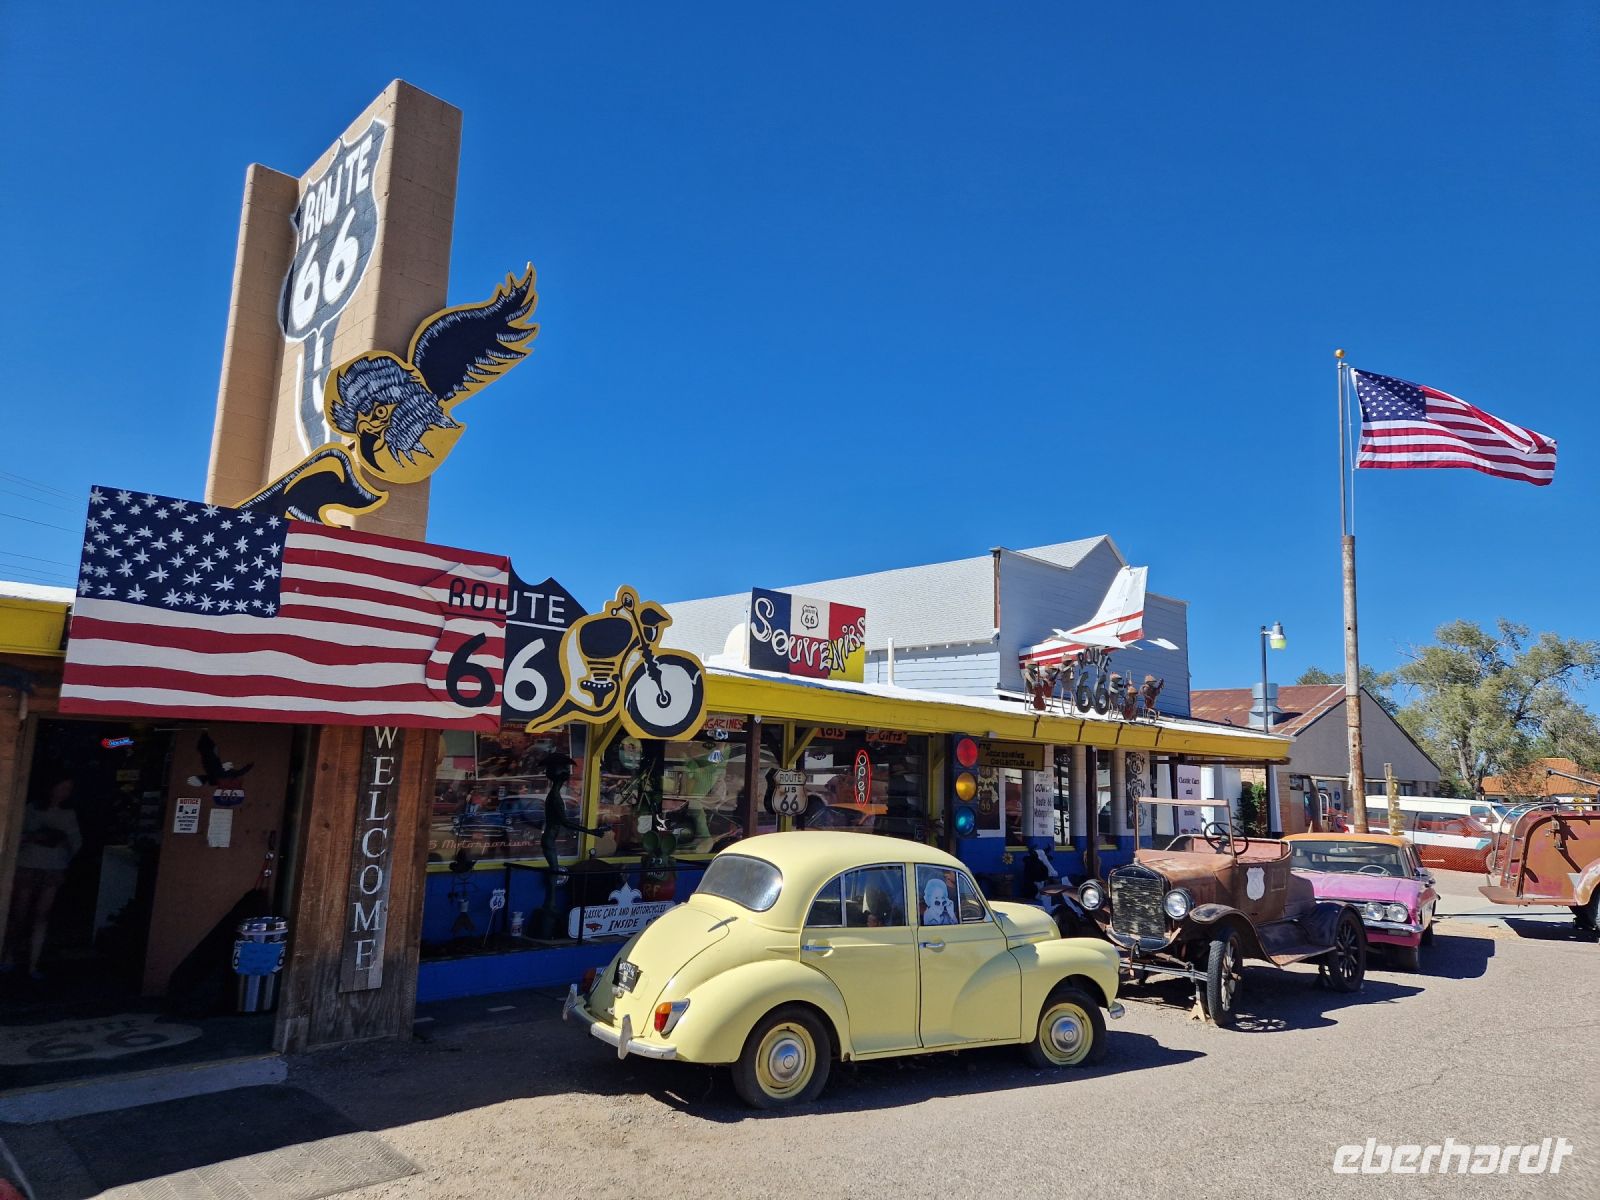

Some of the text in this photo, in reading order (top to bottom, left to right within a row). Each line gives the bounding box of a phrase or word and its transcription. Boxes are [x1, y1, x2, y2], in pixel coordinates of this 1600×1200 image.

[302, 135, 372, 244] ROUTE
[291, 207, 359, 331] 66
[449, 578, 565, 623] ROUTE
[804, 615, 815, 625] 66
[446, 632, 548, 712] 66
[1077, 646, 1112, 672] ROUTE
[1075, 671, 1110, 715] 66
[780, 773, 802, 783] ROUTE
[780, 795, 799, 812] 66
[352, 726, 398, 970] WELCOME
[603, 907, 617, 919] CARS
[608, 918, 638, 931] INSIDE
